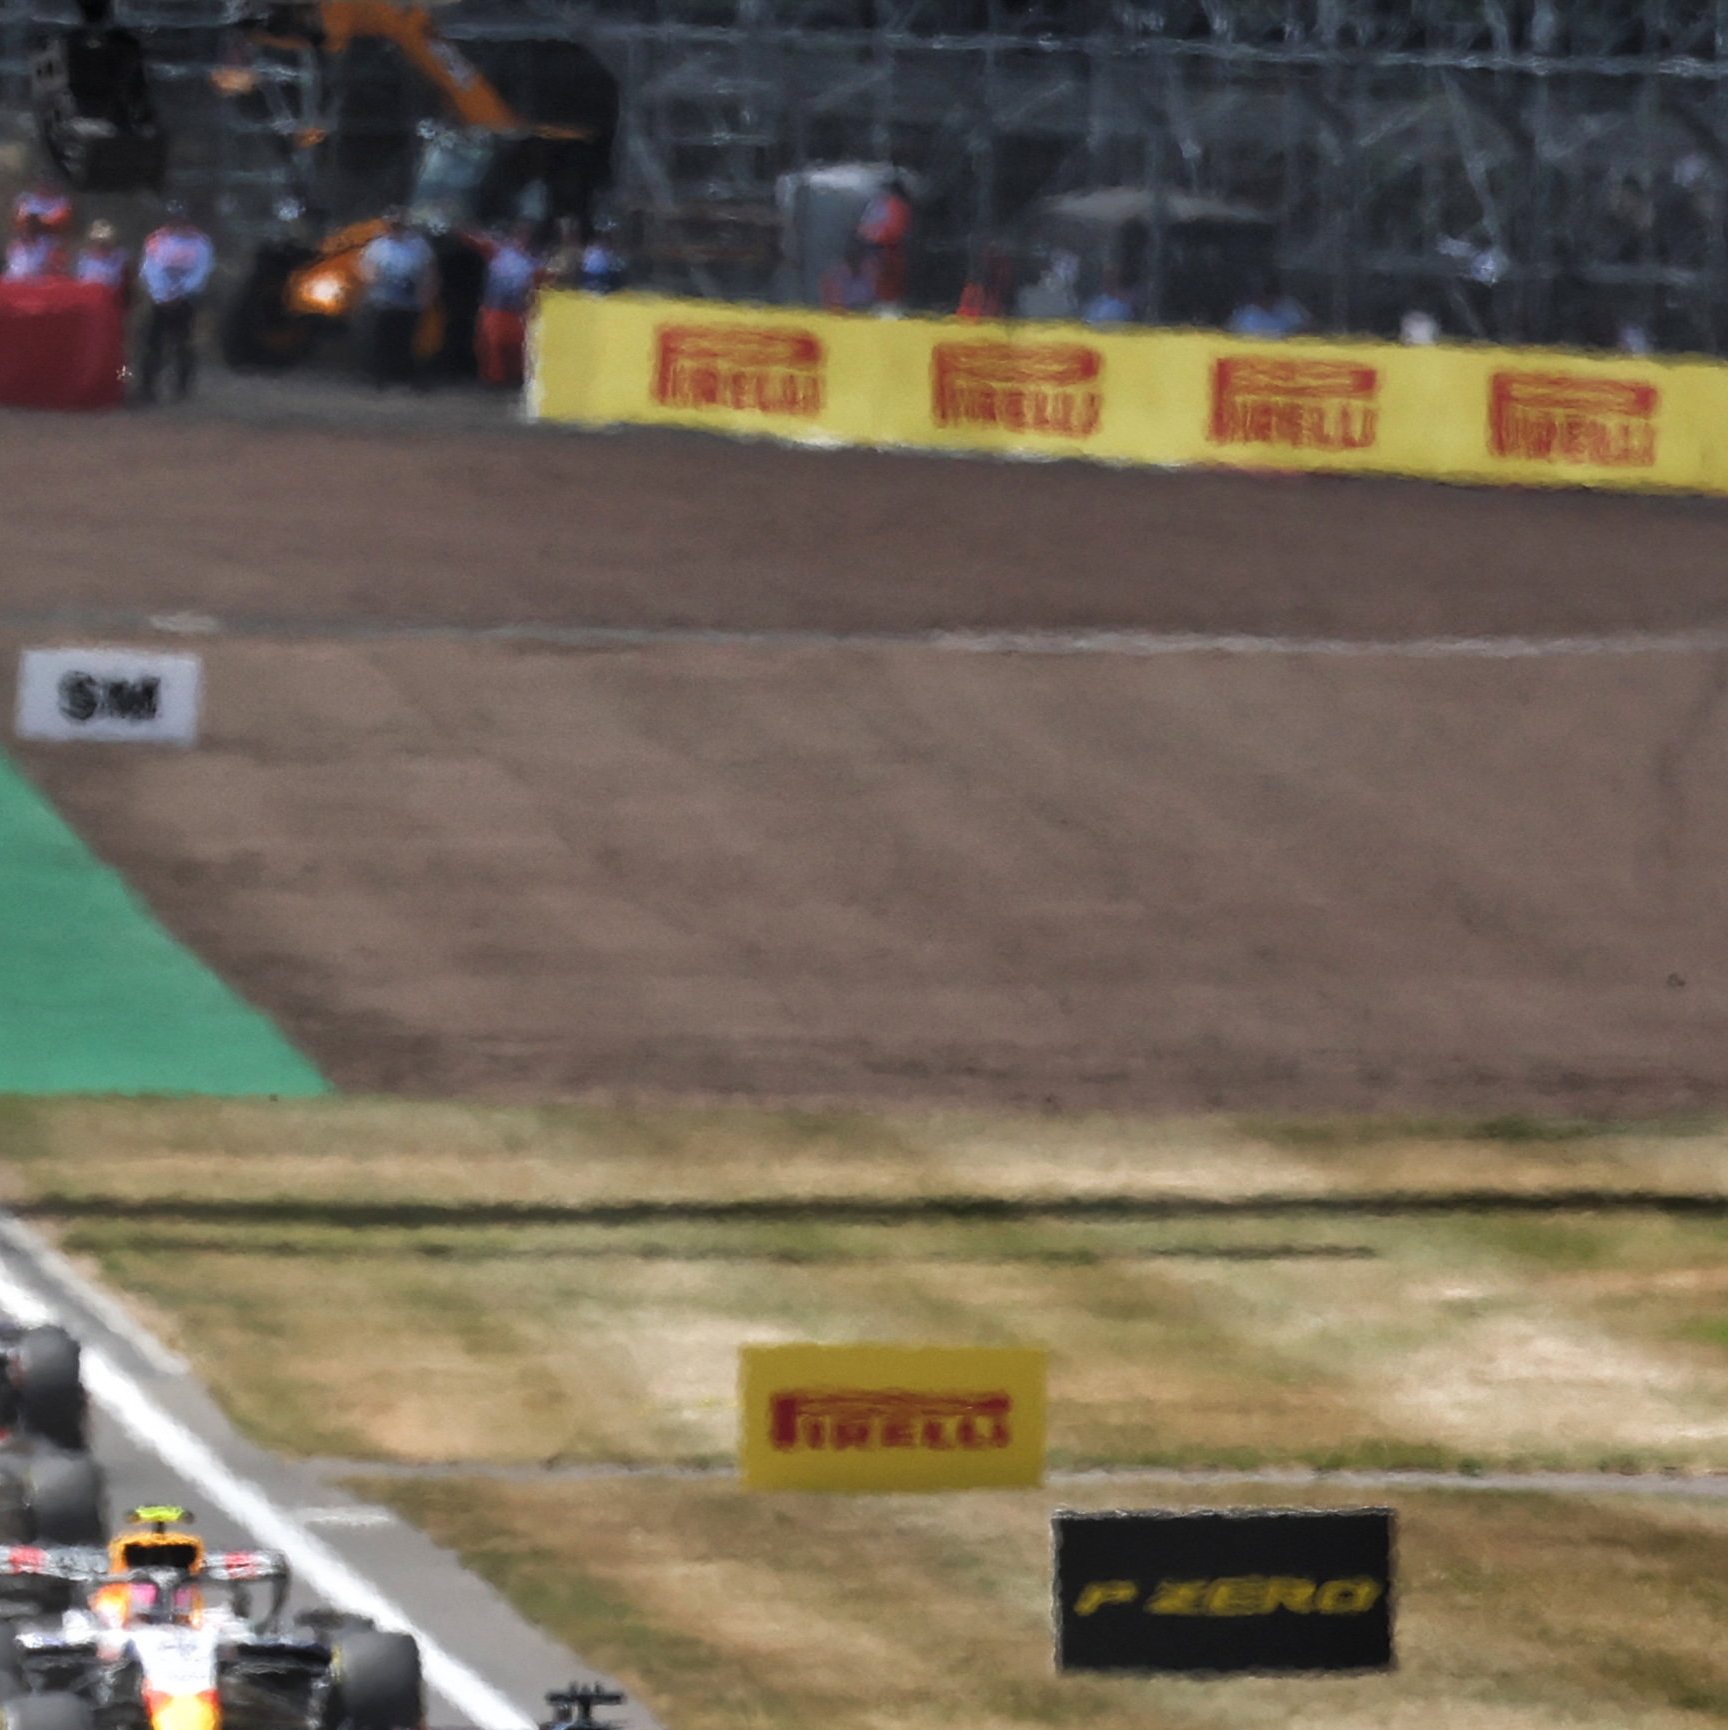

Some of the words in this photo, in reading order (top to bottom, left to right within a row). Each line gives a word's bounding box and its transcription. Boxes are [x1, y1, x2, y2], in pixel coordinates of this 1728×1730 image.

[769, 1389, 1012, 1450] PIRELLI
[1076, 1580, 1137, 1617] P
[1149, 1576, 1377, 1617] ZERO
